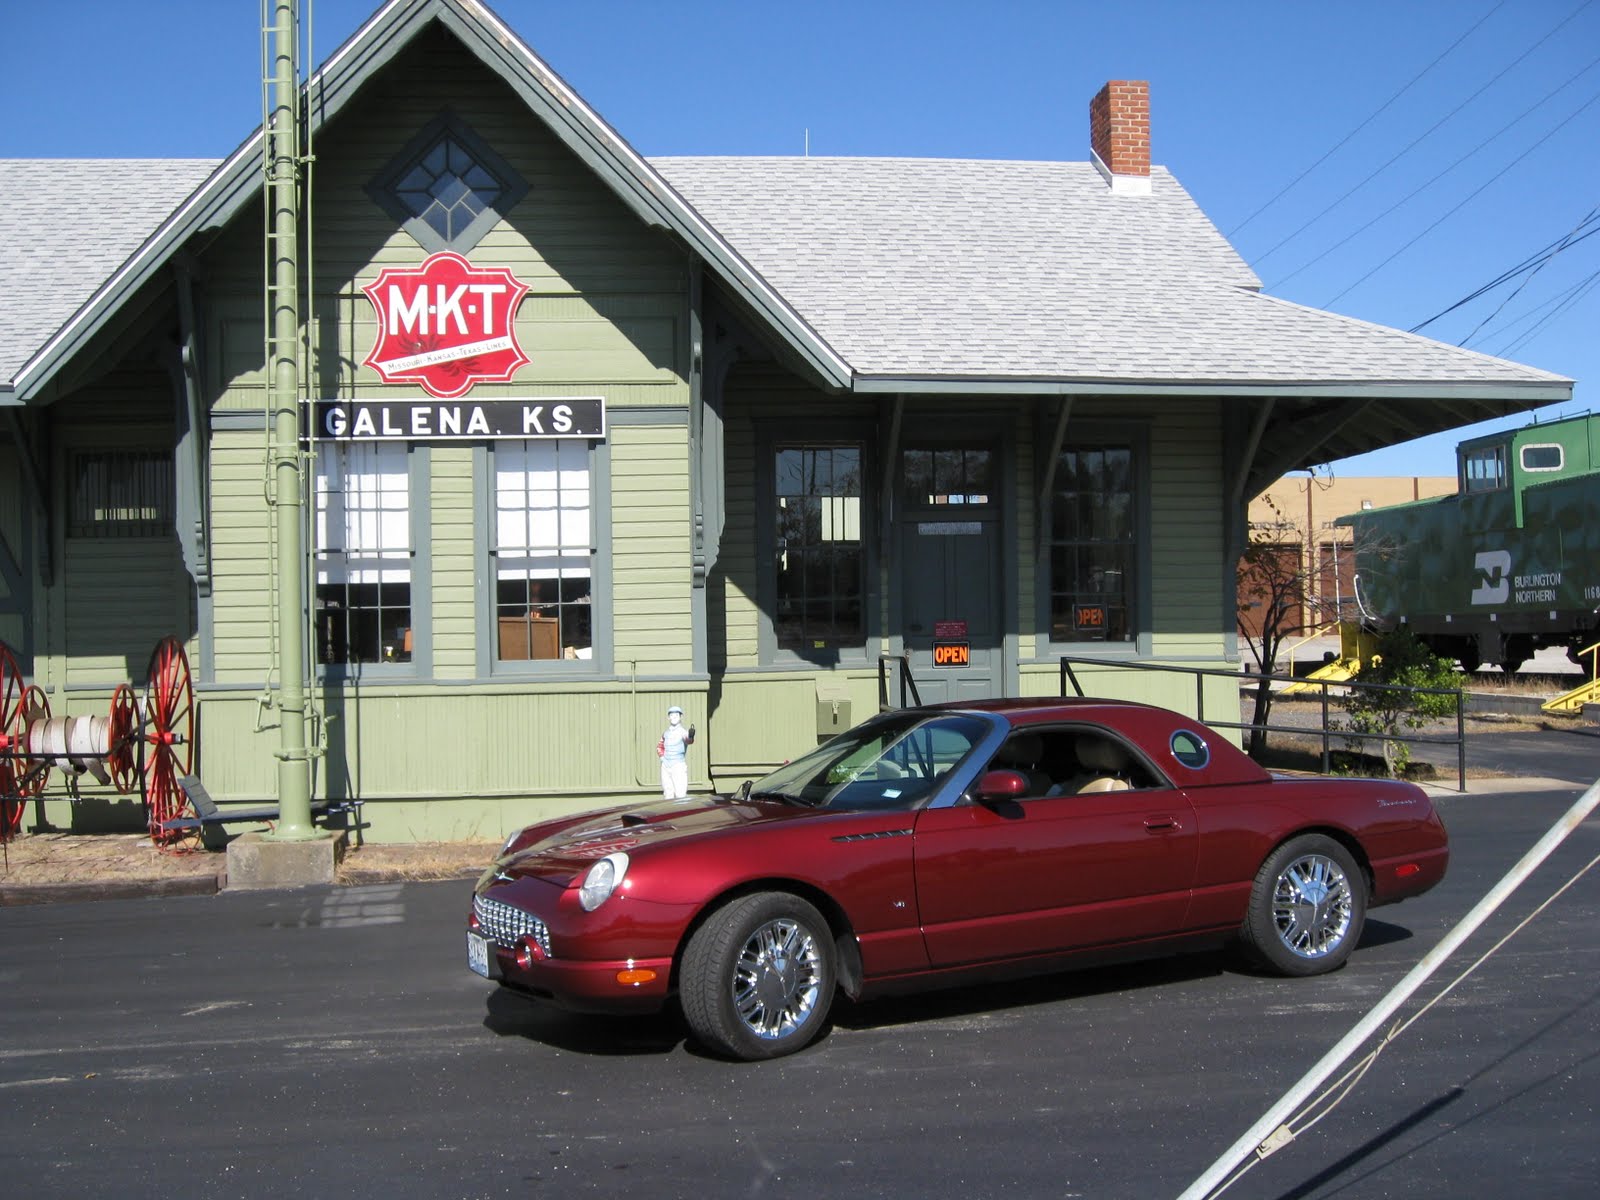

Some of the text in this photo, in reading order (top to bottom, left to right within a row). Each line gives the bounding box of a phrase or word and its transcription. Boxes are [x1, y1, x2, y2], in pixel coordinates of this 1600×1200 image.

[1514, 573, 1561, 588] BURLINGTON
[1515, 589, 1556, 603] NORTHERN
[935, 646, 967, 663] OPEN
